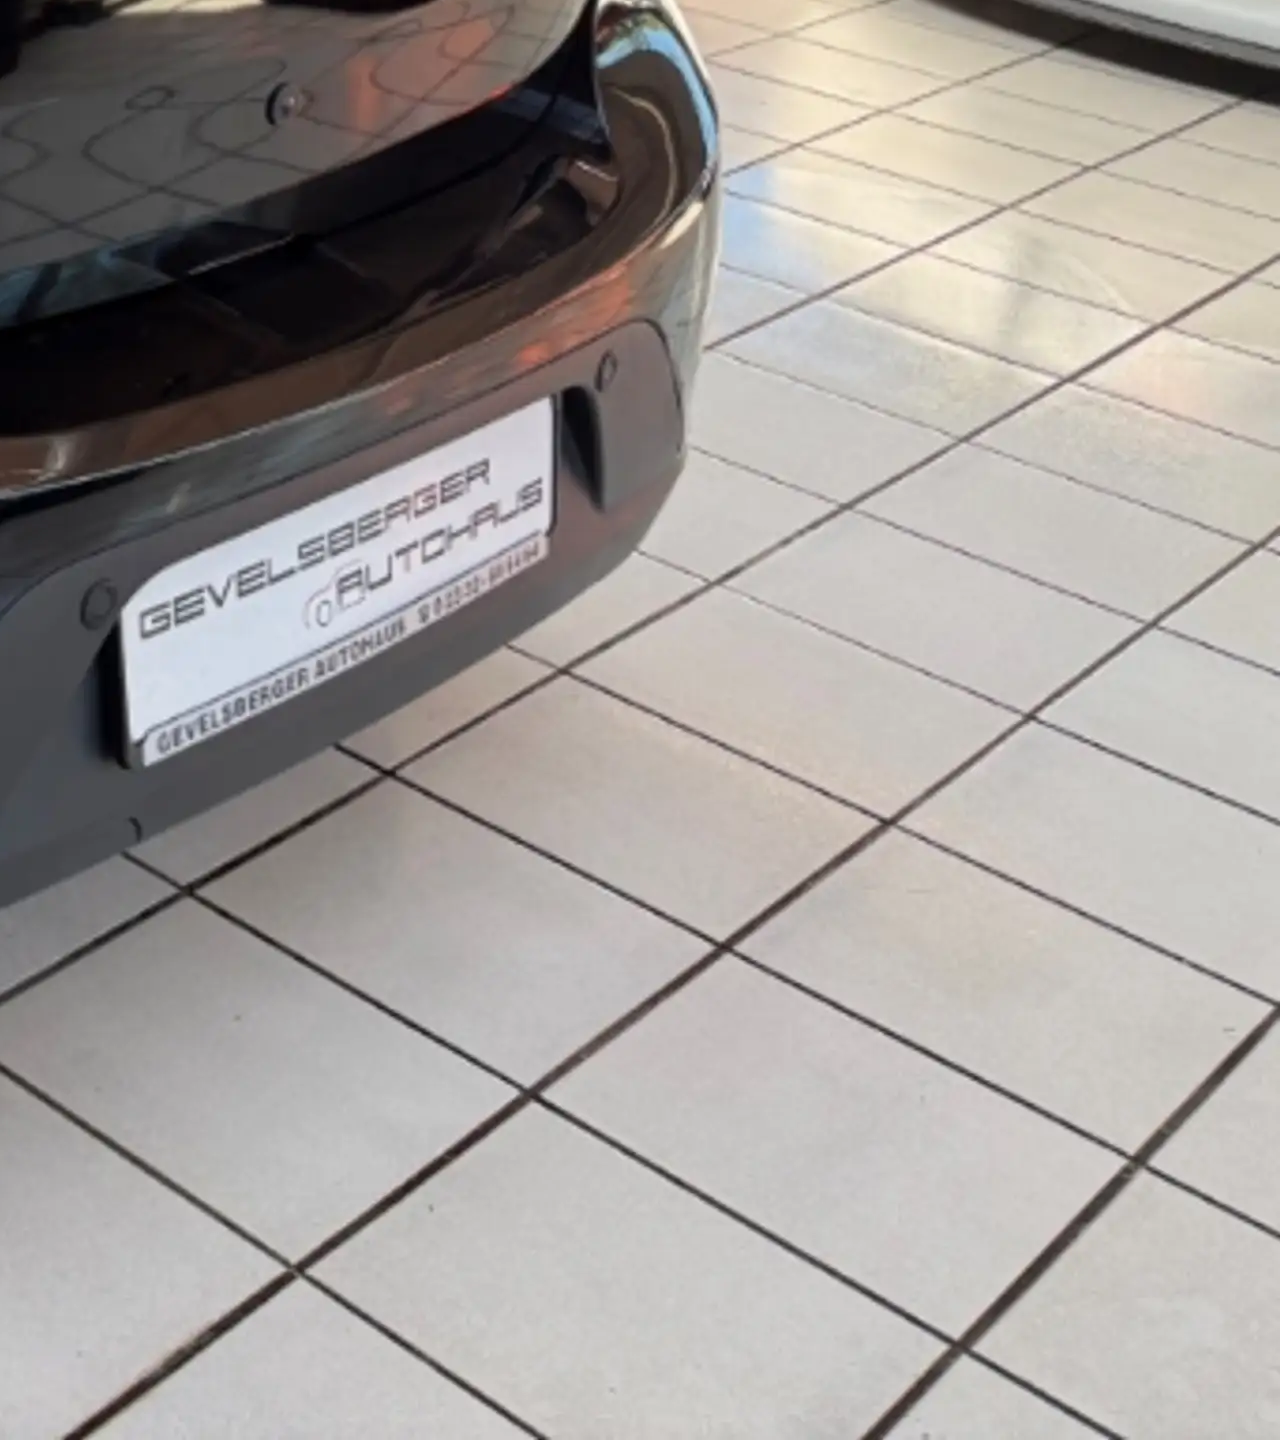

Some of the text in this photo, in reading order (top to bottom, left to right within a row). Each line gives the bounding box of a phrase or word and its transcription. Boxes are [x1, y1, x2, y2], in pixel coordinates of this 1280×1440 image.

[138, 457, 491, 641] GEVELSBERGER
[335, 476, 544, 606] AUTOHAUS
[155, 666, 310, 754] GEVELSBERGER
[315, 615, 407, 680] AUTOHAUS
